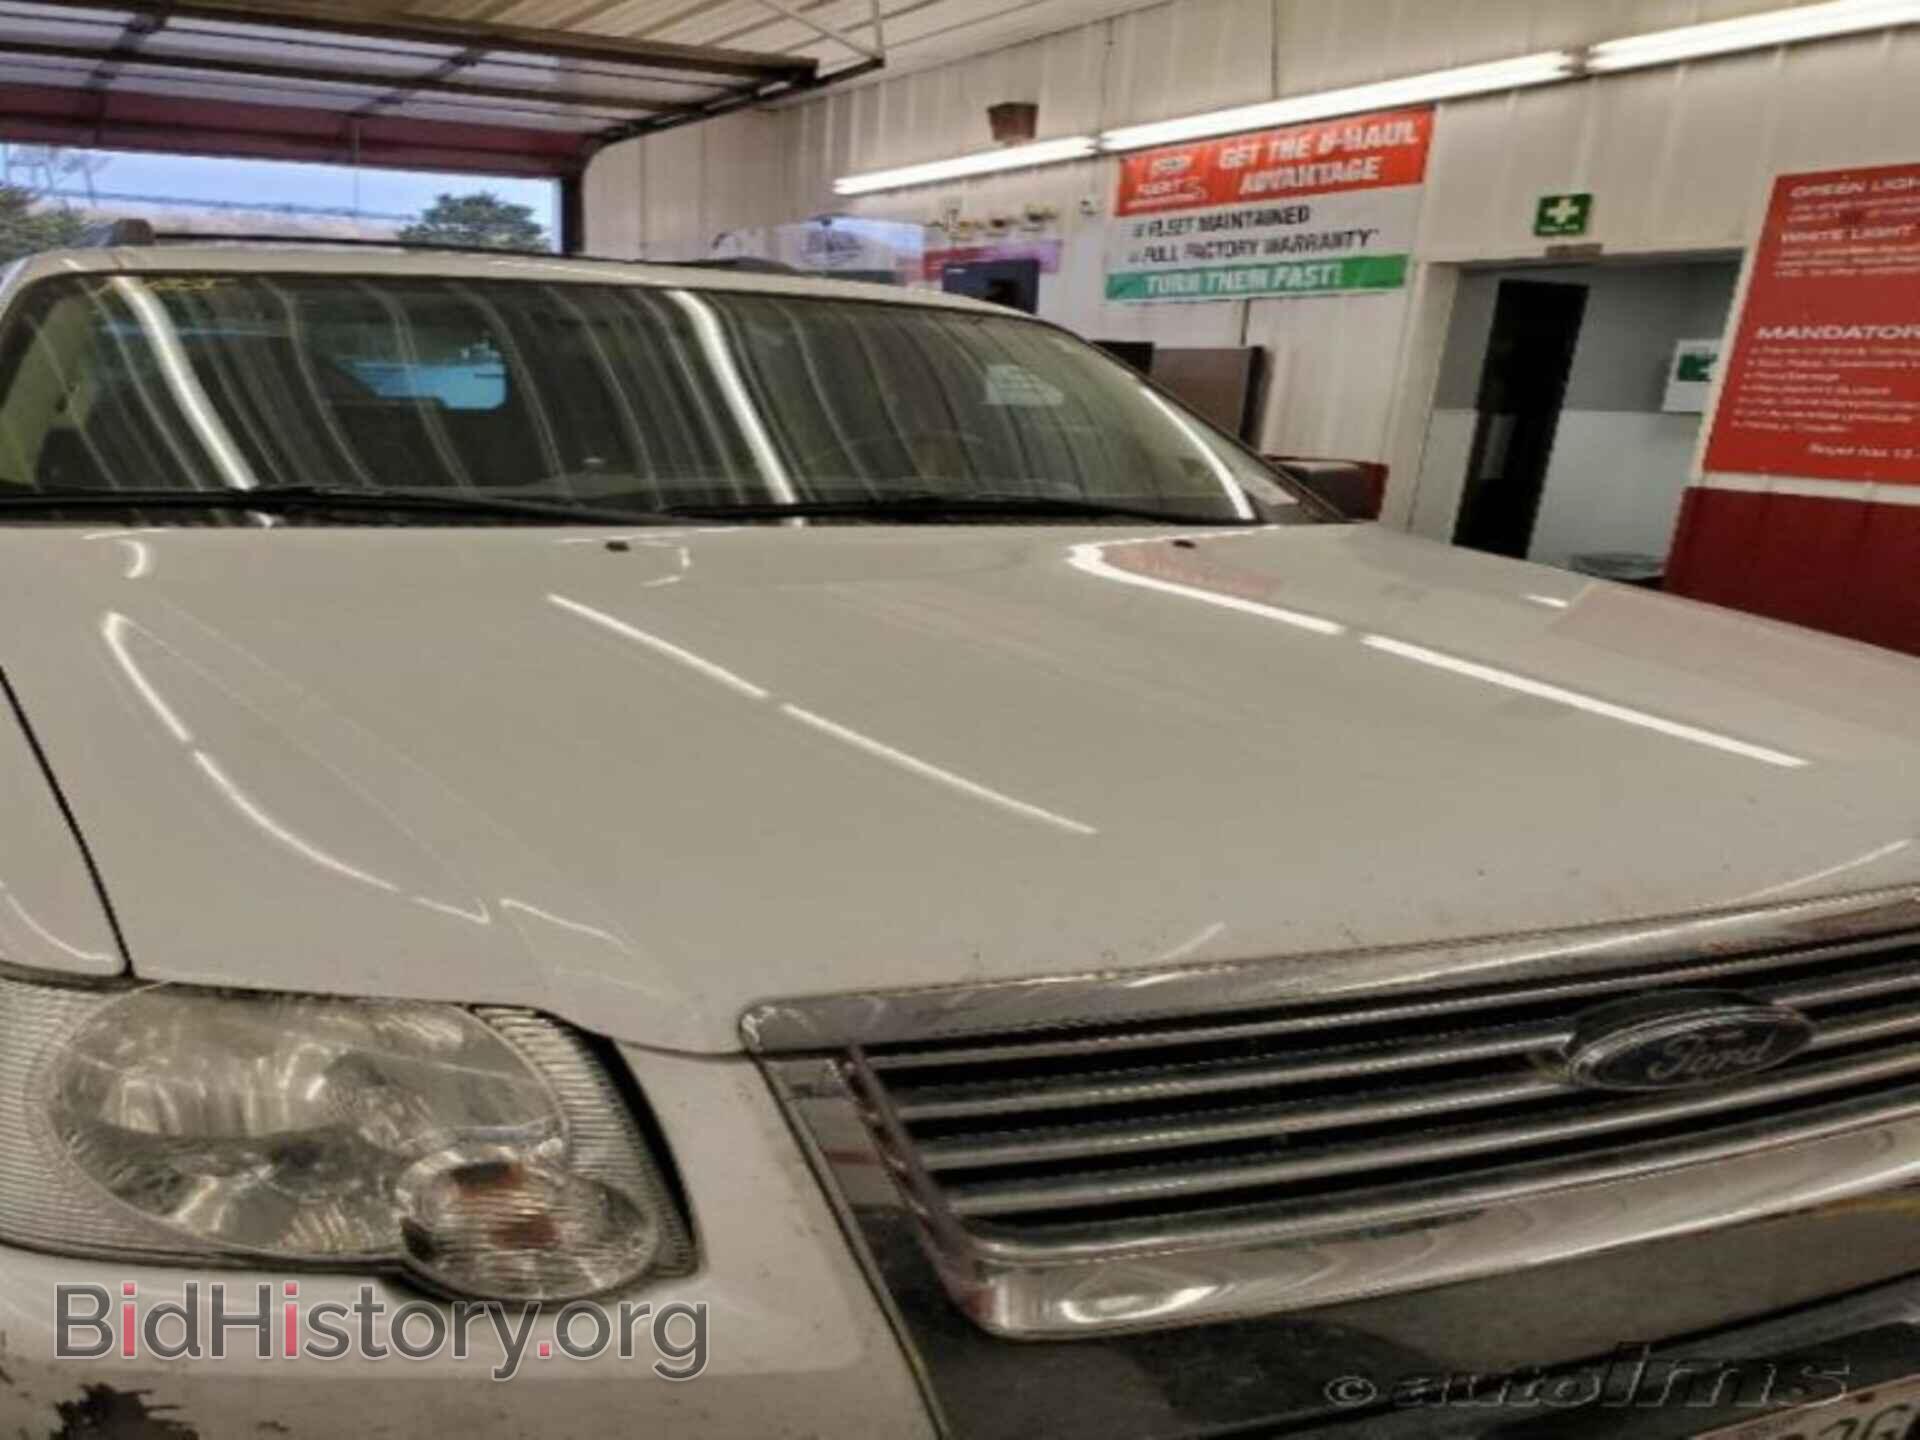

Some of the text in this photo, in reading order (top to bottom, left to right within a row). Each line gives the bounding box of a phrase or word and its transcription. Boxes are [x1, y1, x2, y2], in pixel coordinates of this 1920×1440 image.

[1219, 143, 1262, 169] GET
[1268, 134, 1314, 162] THE
[1240, 155, 1383, 194] ADVANTAGE
[1789, 181, 1865, 198] GREEN
[1199, 205, 1310, 233] MAINTAINED
[1781, 224, 1914, 244] WHITE LIGHT
[1146, 272, 1196, 295] TURN
